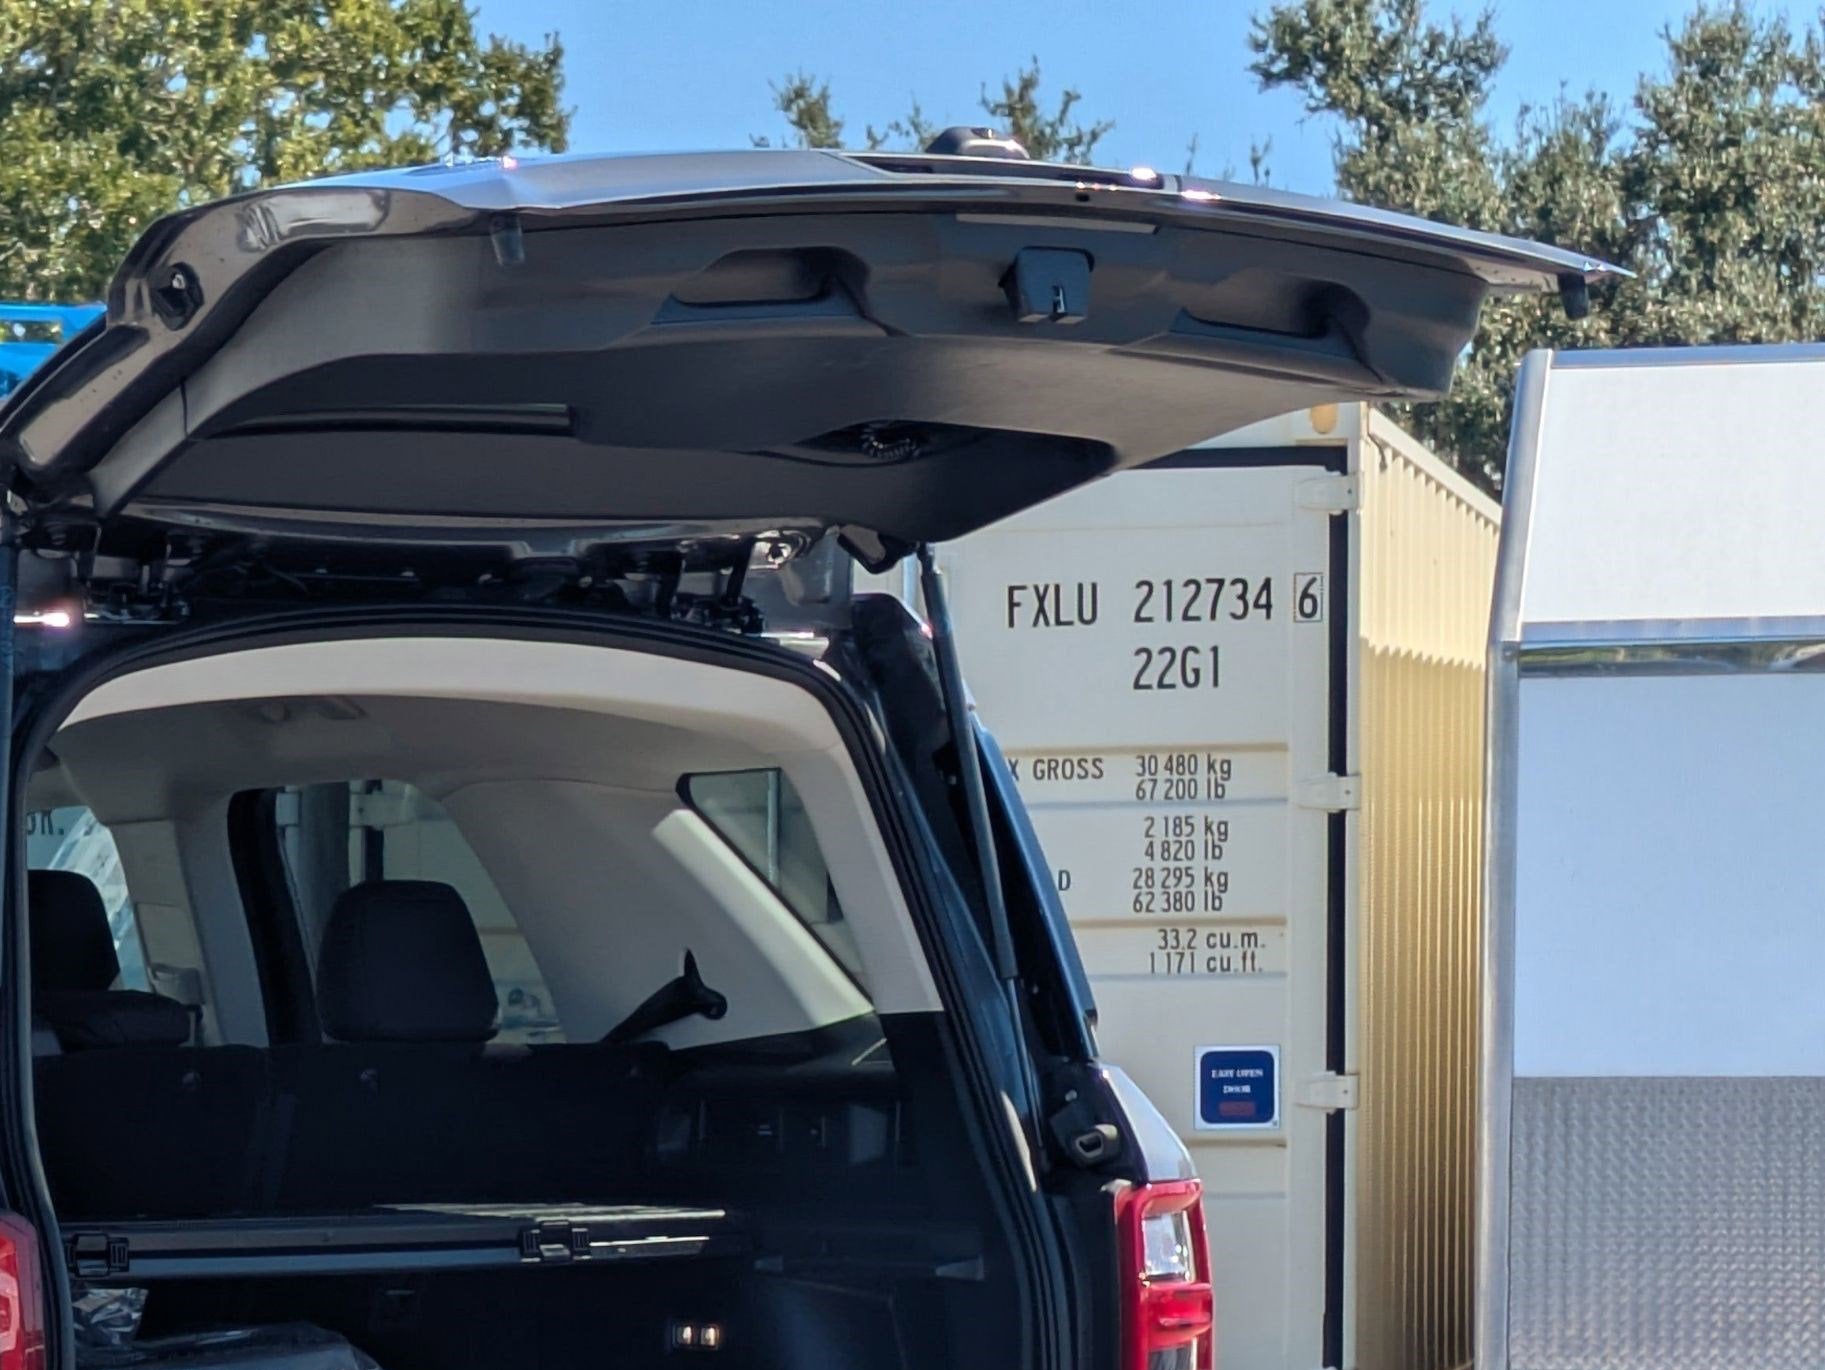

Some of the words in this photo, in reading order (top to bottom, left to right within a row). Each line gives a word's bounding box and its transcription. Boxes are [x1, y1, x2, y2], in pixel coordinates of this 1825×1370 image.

[1007, 582, 1098, 629] FXLU
[1133, 576, 1273, 623] 212734
[1298, 576, 1319, 619] 6
[1132, 645, 1219, 691] 22G1
[1032, 757, 1104, 781] GROSS
[1206, 752, 1232, 783] kg
[1206, 777, 1229, 801] lb
[1204, 815, 1229, 845] kg
[1204, 838, 1226, 861] lb
[1204, 866, 1229, 895] kg
[1203, 889, 1226, 912] lb
[1157, 927, 1197, 951] 33.2
